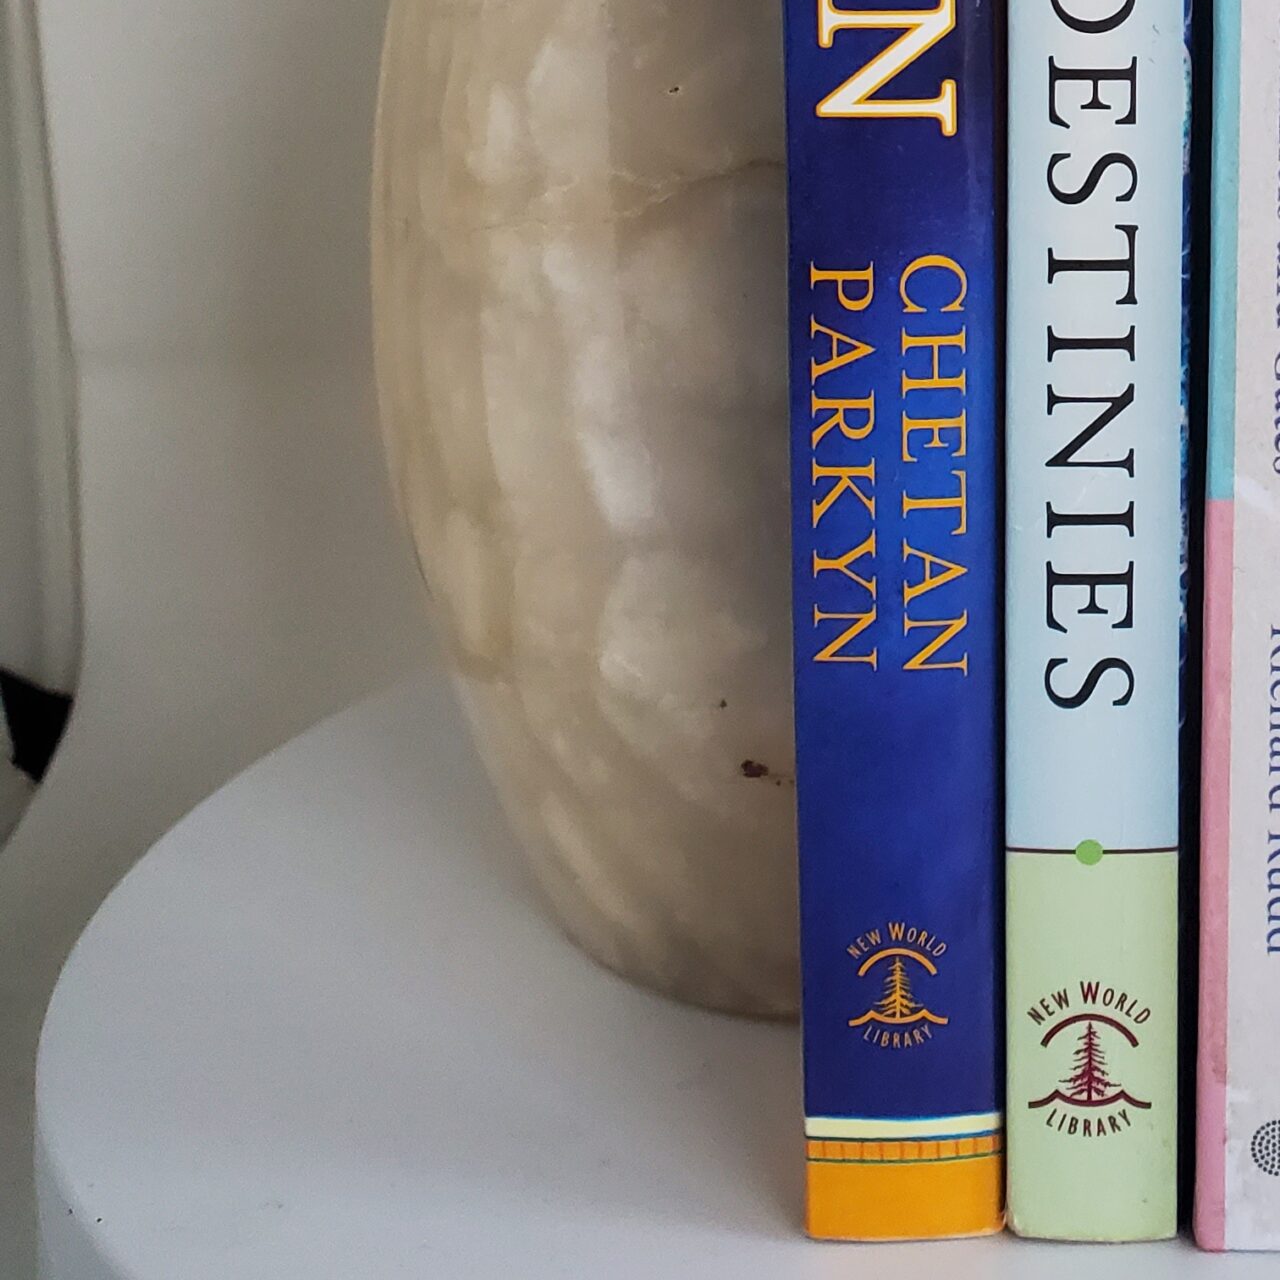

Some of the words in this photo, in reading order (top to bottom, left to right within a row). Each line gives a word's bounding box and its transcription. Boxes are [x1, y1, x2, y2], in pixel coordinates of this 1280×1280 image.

[810, 261, 877, 670] PARKYN
[899, 254, 968, 676] CHETAN
[846, 928, 882, 960] NEW
[888, 921, 948, 958] WORLD
[1027, 988, 1070, 1026] NEW
[1079, 980, 1151, 1024] WORLD
[863, 1023, 933, 1049] LIBRARY
[1046, 1108, 1132, 1138] LIBRARY
